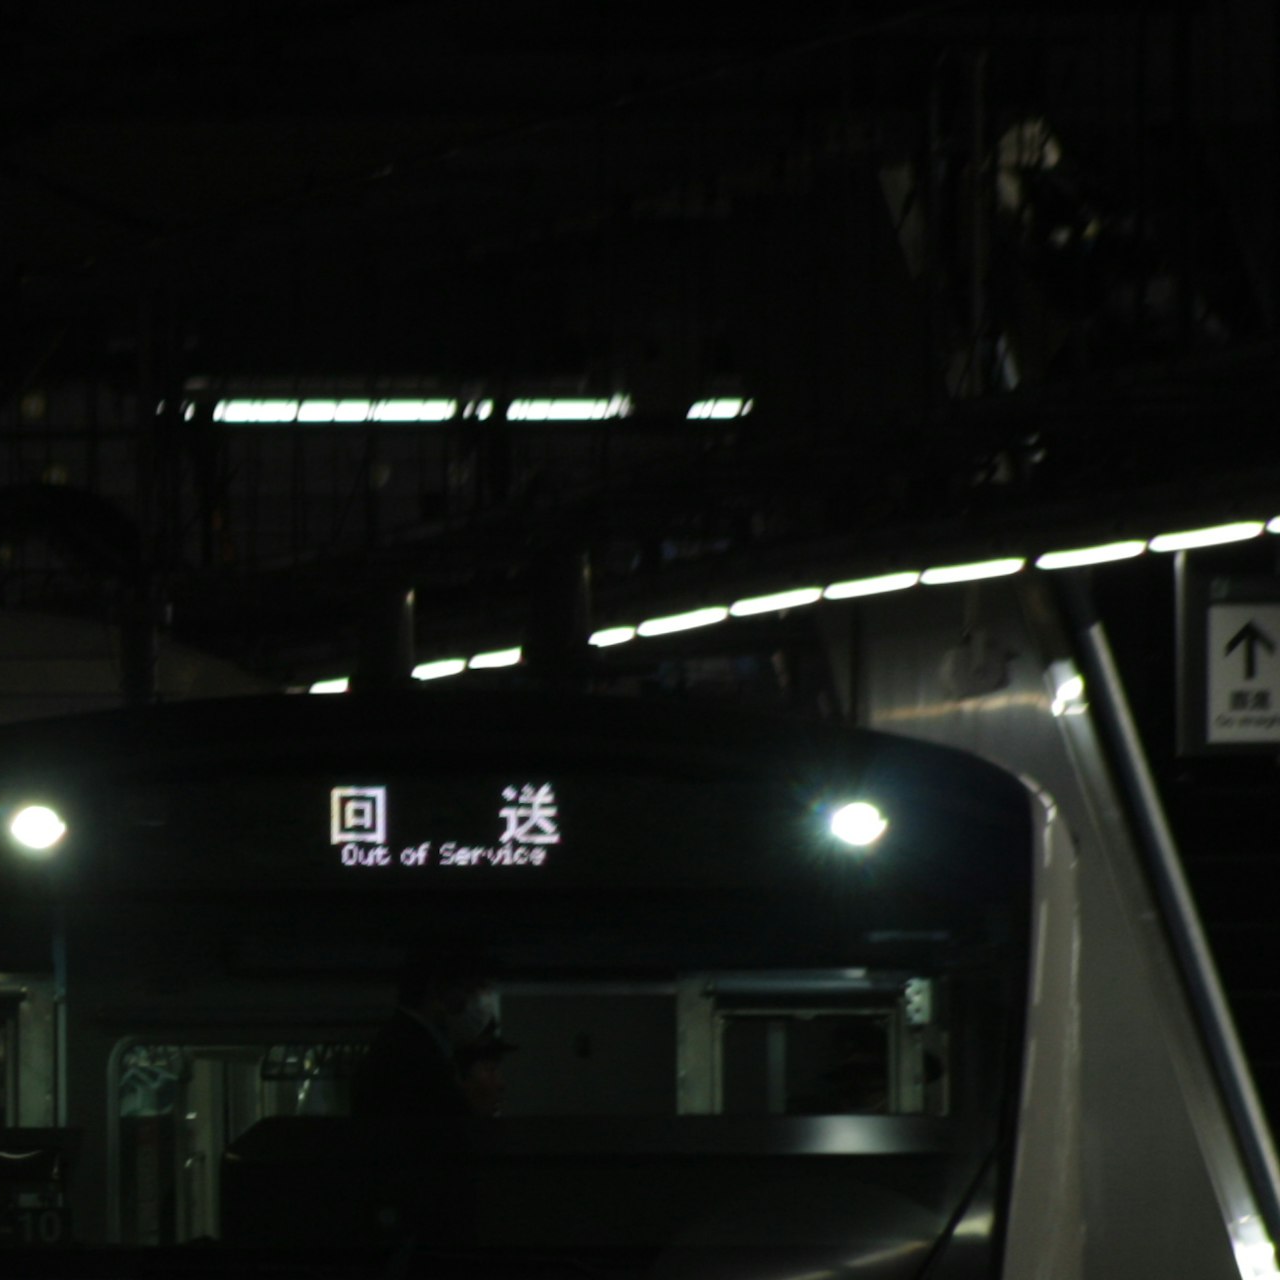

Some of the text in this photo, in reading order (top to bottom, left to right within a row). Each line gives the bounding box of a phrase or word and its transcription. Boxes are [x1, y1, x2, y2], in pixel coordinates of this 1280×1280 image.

[341, 841, 547, 866] Out of Service
